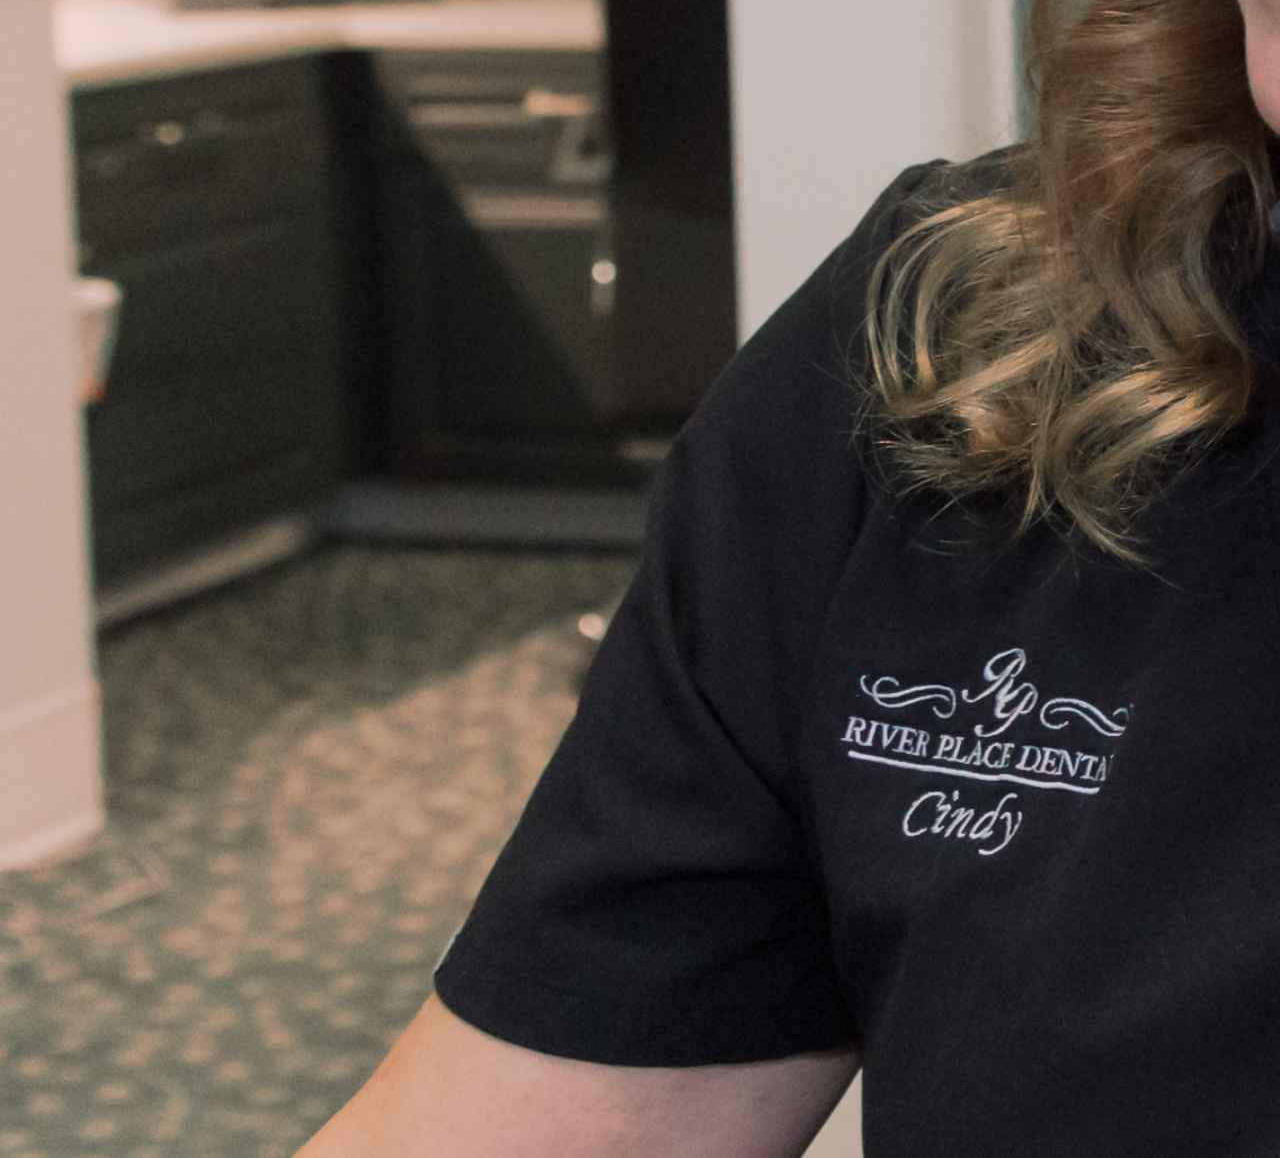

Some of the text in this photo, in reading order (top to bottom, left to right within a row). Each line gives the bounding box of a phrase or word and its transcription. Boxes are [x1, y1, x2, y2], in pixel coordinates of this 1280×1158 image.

[840, 716, 1114, 782] RIVER PLACE DENTA
[902, 790, 1023, 856] Cindy
